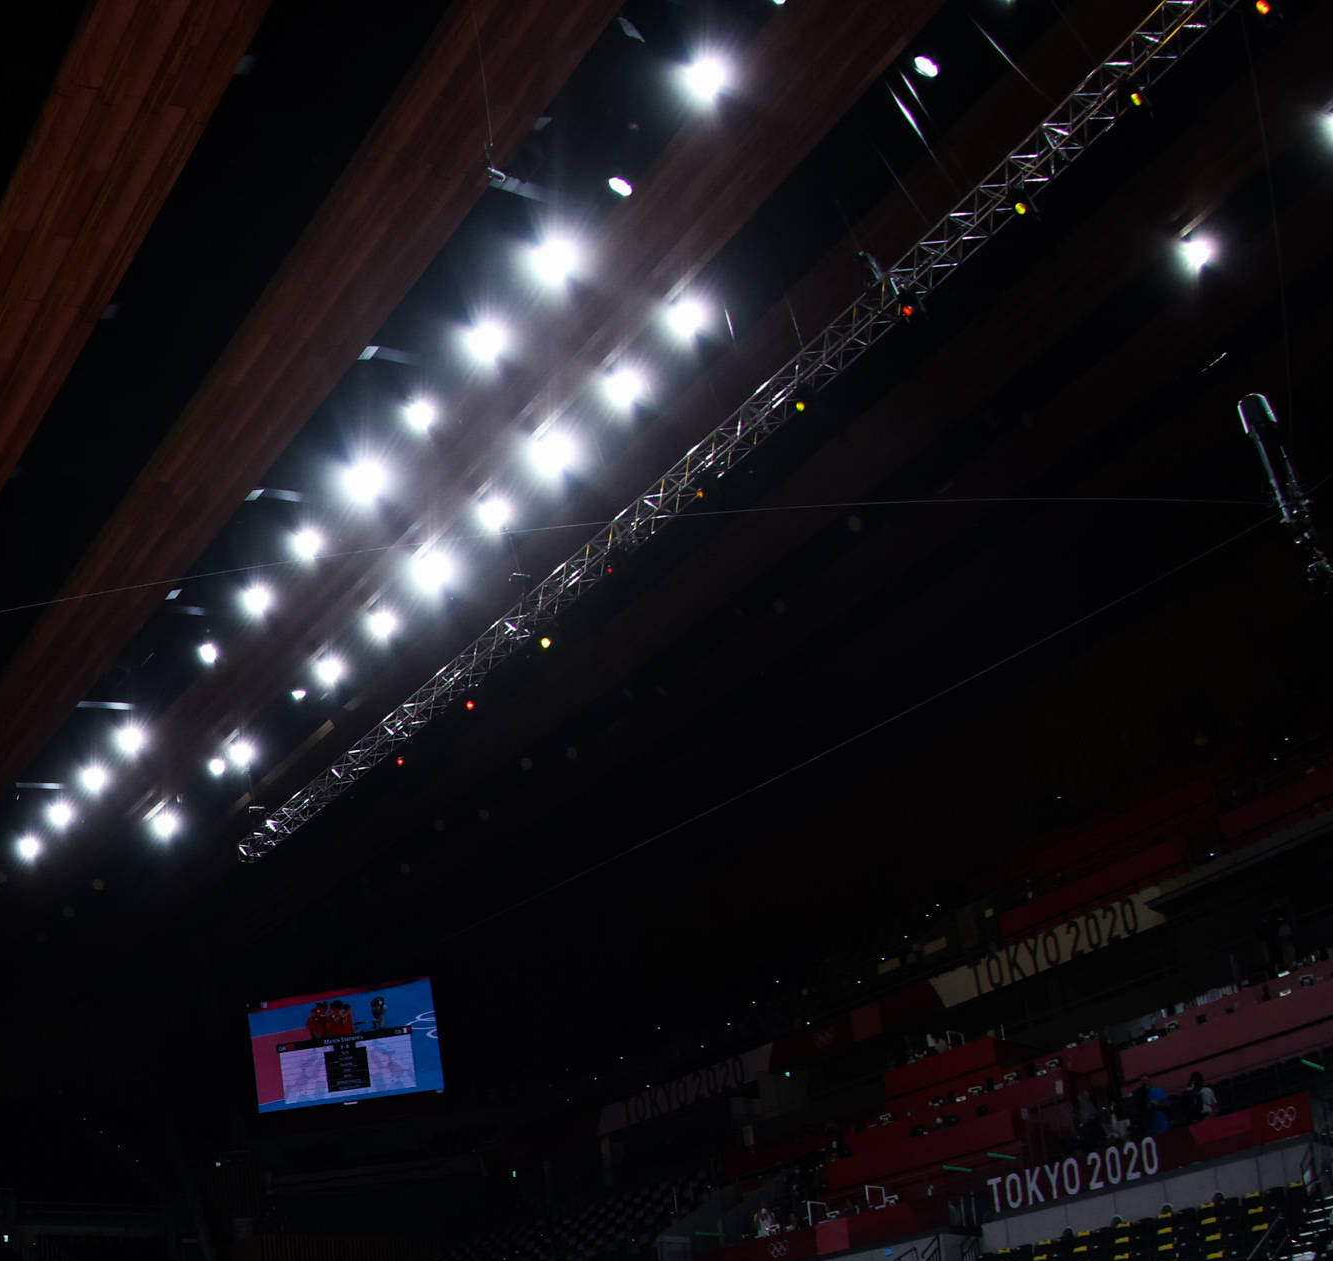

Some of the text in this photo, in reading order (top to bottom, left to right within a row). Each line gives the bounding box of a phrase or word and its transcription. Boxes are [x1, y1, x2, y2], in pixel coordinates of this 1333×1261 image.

[969, 897, 1138, 996] TOKYO 2020
[986, 1136, 1161, 1214] TOKYO 2020
